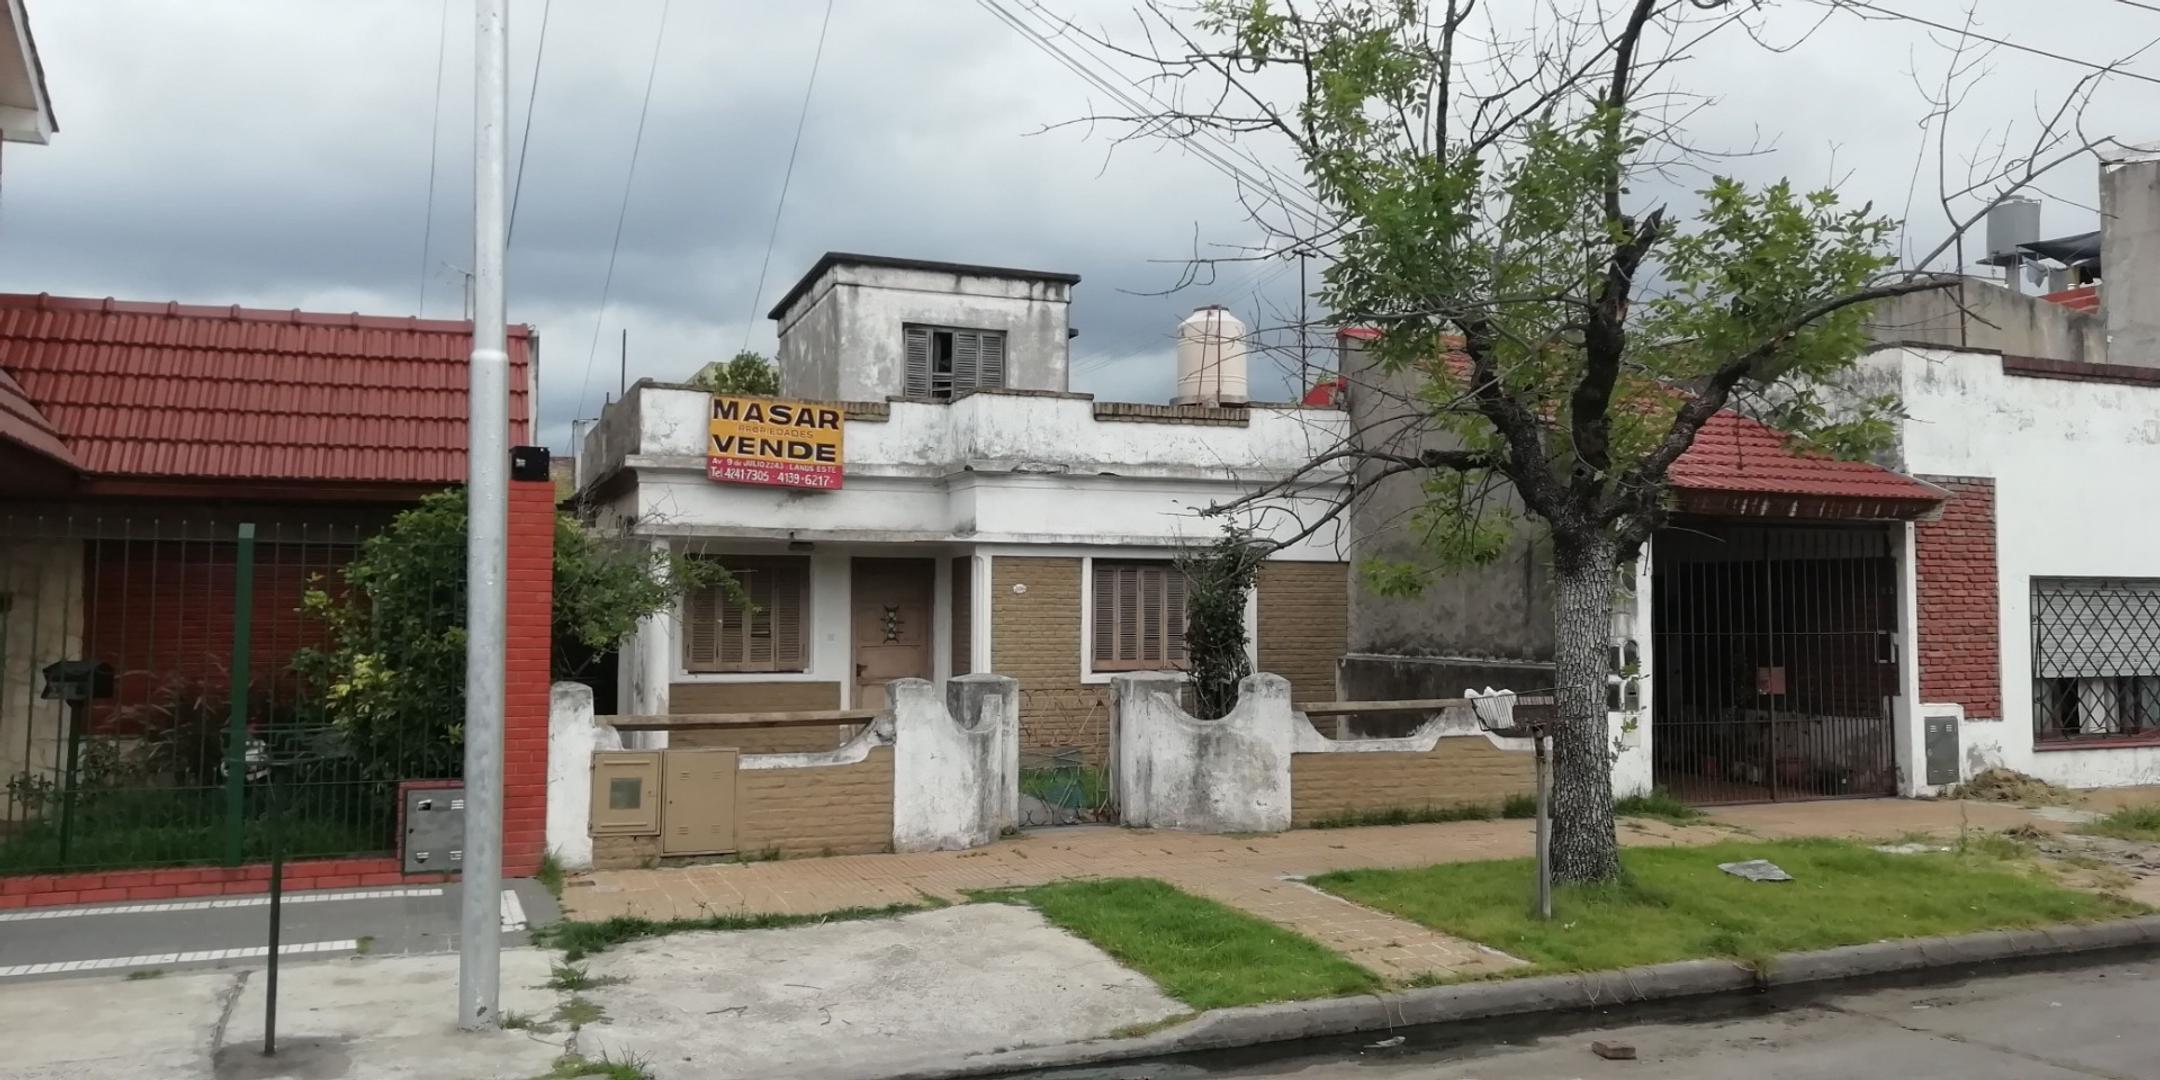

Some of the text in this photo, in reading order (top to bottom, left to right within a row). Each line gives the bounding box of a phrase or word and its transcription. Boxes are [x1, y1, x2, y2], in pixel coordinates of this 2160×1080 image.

[712, 399, 840, 430] MASAR
[738, 424, 814, 439] PROPIEDADES
[712, 434, 837, 462] VENDE
[726, 458, 733, 466] 9
[743, 460, 765, 468] JULIO
[789, 464, 815, 472] LANUS
